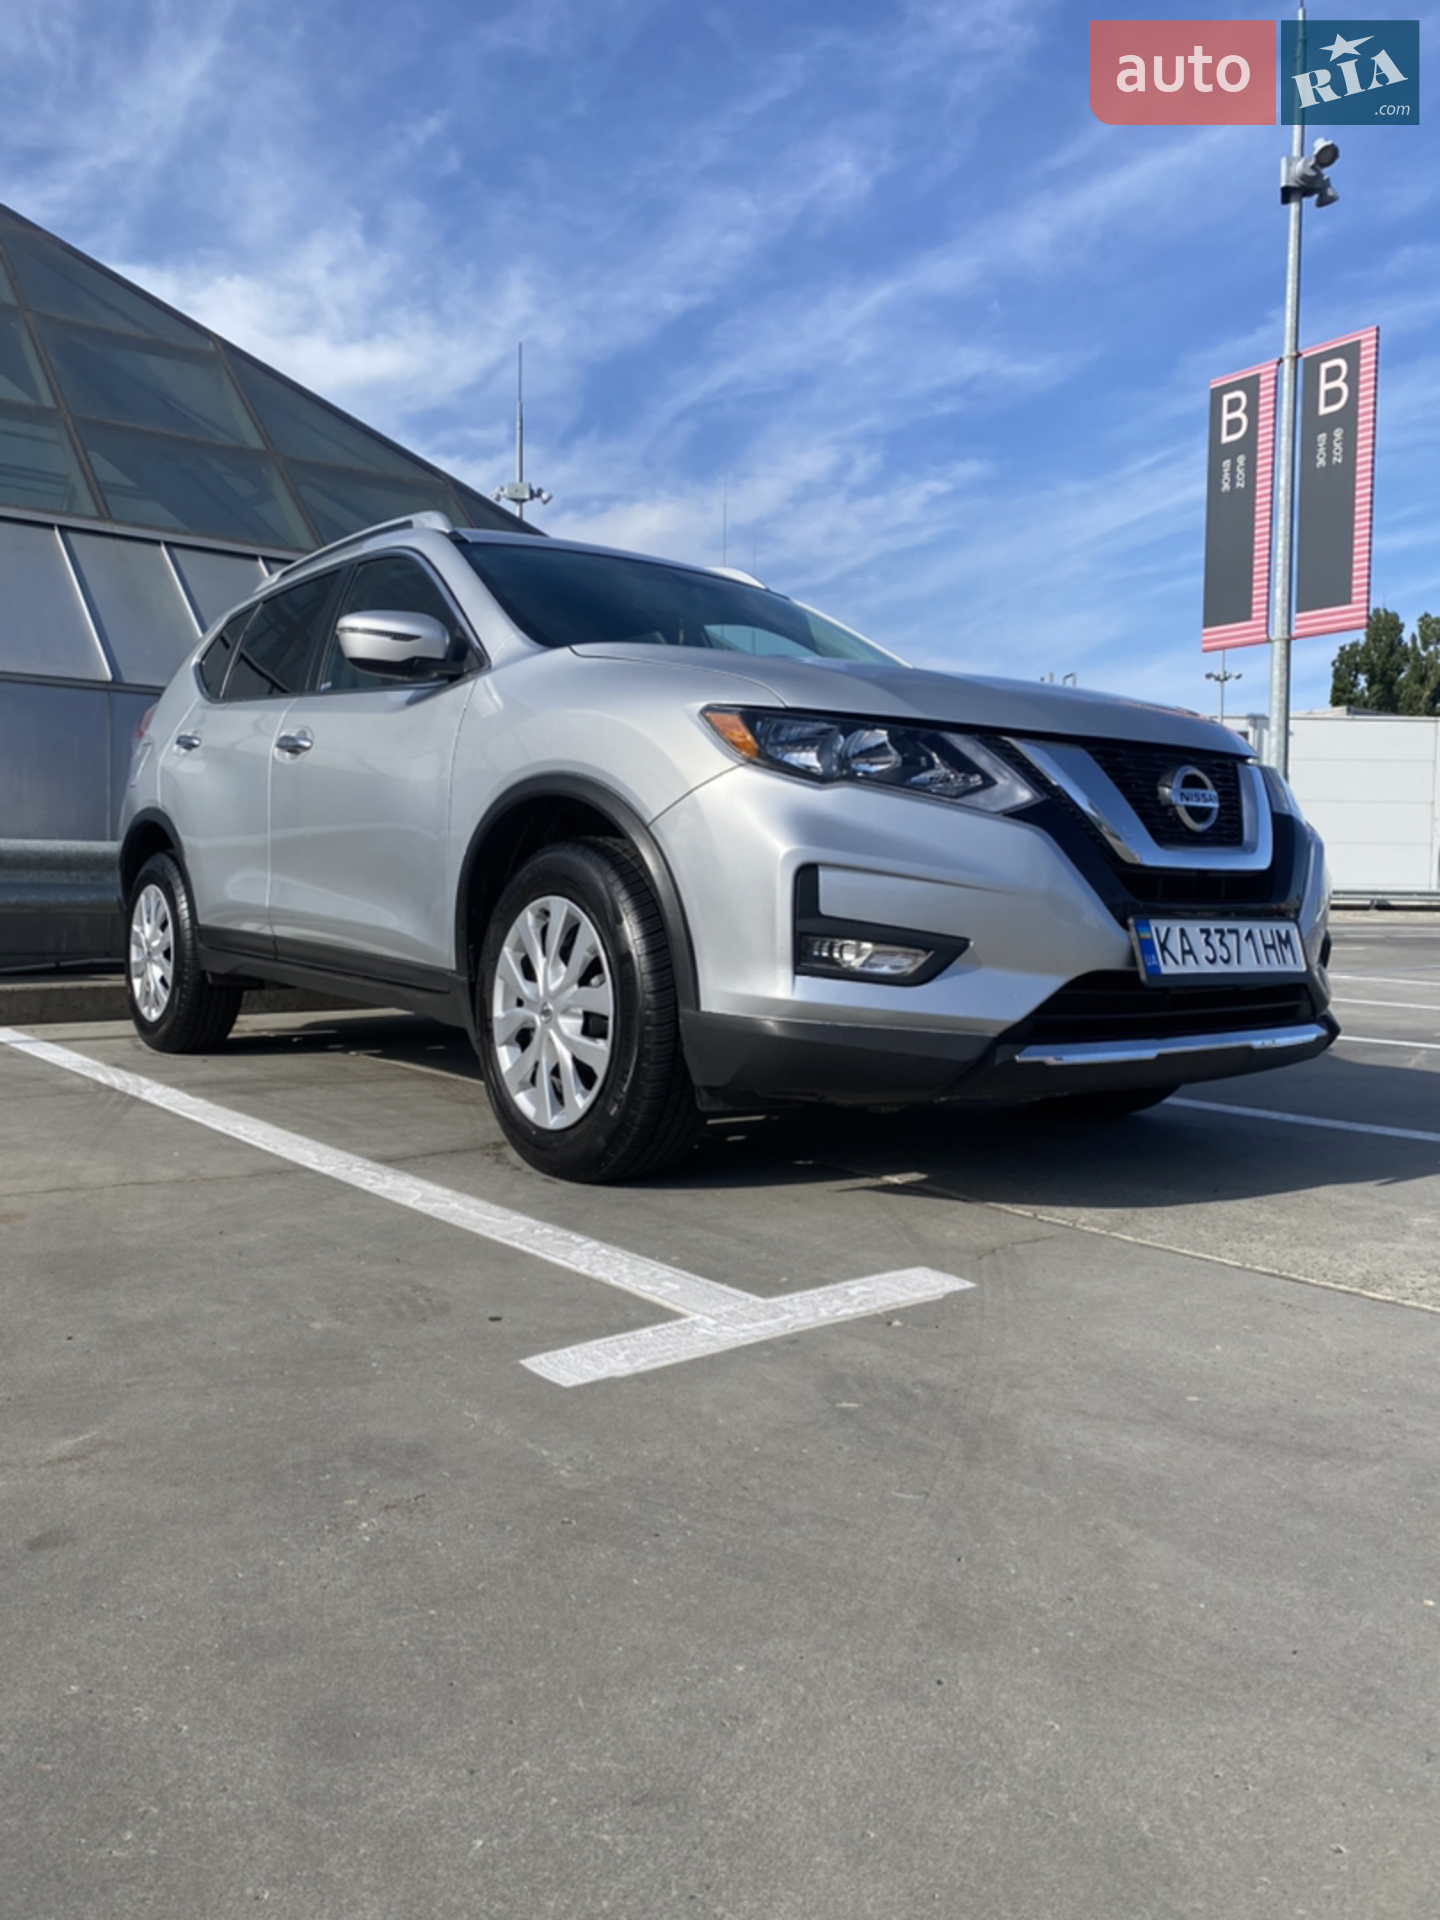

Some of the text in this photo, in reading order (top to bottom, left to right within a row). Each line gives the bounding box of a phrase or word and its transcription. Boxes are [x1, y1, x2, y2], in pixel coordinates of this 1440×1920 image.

[1317, 357, 1350, 417] B
[1220, 390, 1249, 445] B
[1332, 427, 1344, 465] zone
[1236, 454, 1246, 489] zone
